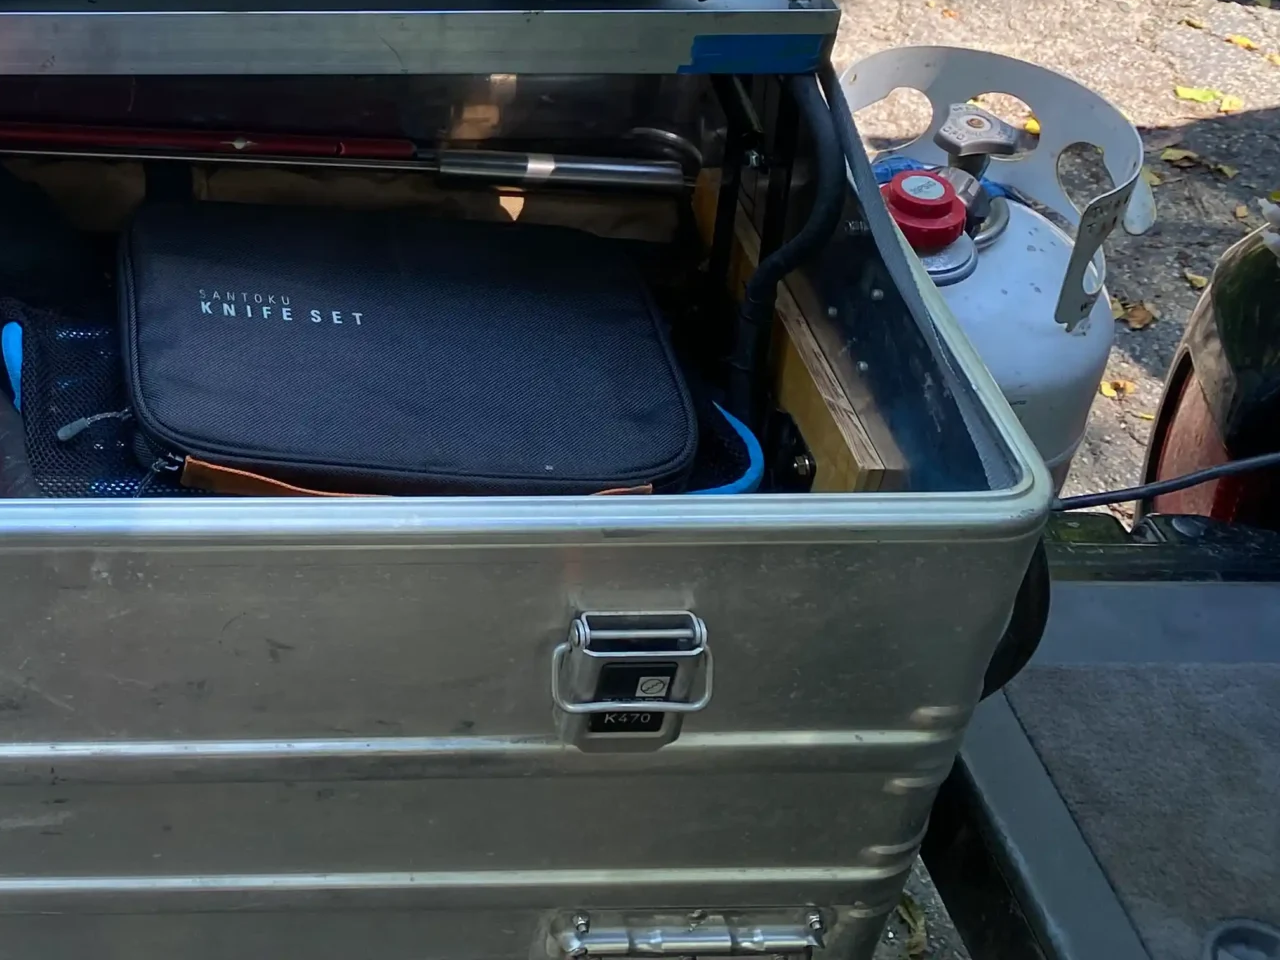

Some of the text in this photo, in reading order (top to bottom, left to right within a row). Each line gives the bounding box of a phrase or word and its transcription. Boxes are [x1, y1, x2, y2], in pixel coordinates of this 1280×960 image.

[199, 289, 291, 306] SANTOKU
[200, 300, 364, 327] KNIFE SET
[604, 712, 652, 724] K470
